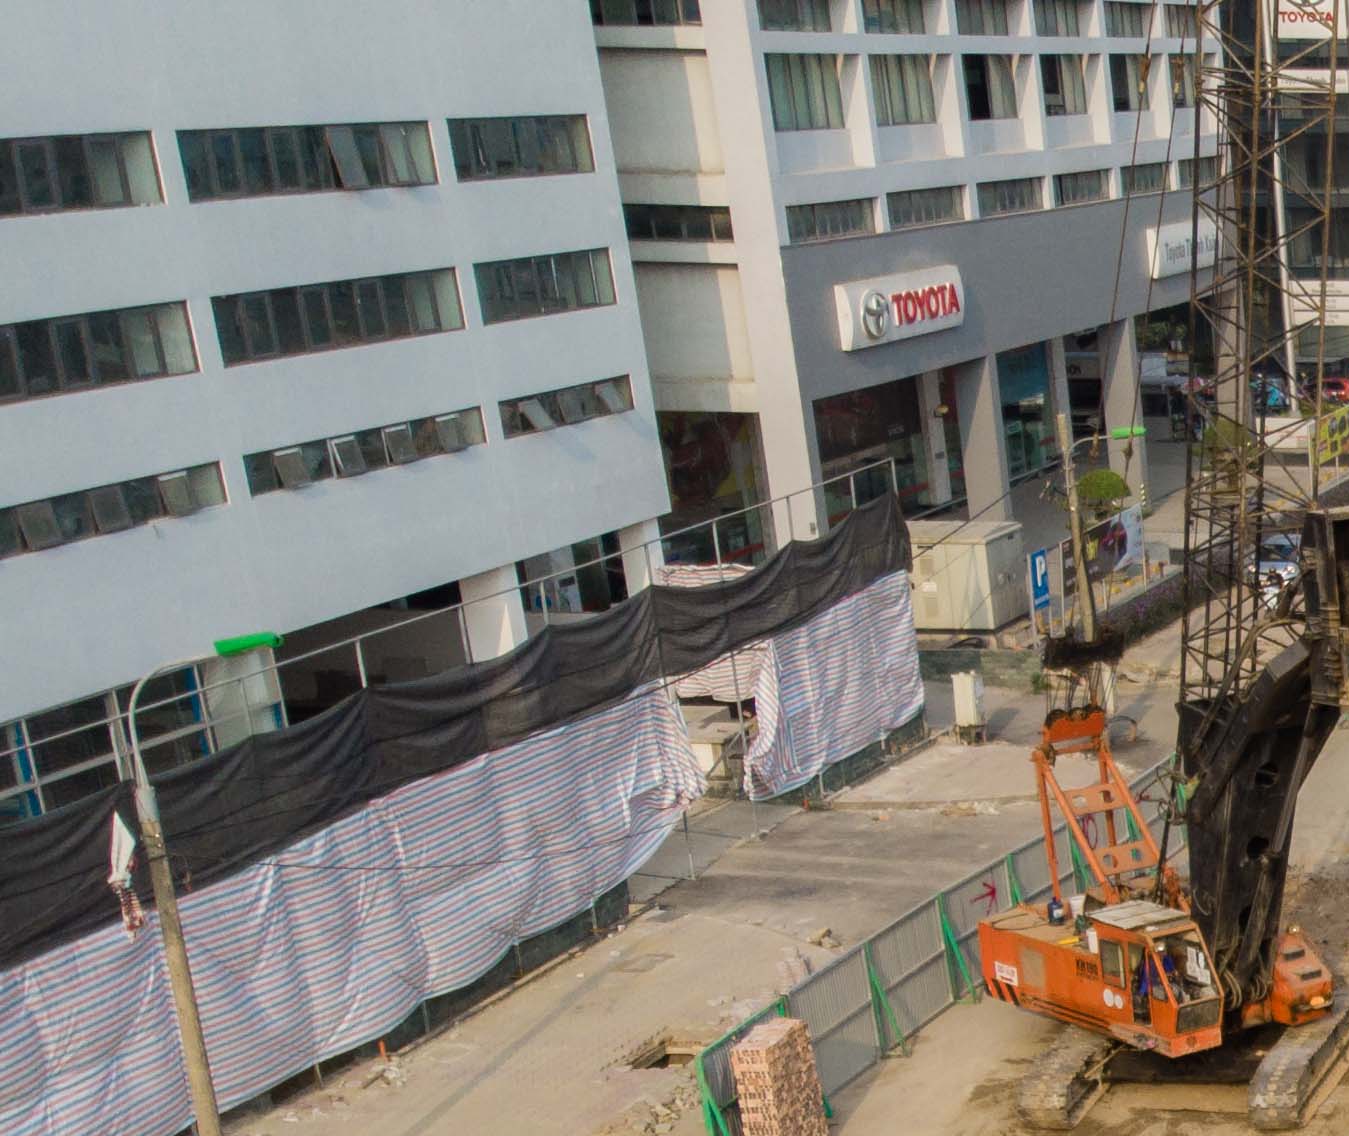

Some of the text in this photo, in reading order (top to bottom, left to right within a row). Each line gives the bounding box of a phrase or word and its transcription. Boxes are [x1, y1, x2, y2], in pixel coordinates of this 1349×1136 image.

[1279, 11, 1334, 23] TOYOTA
[891, 282, 960, 327] TOYOTA
[1035, 555, 1046, 587] P
